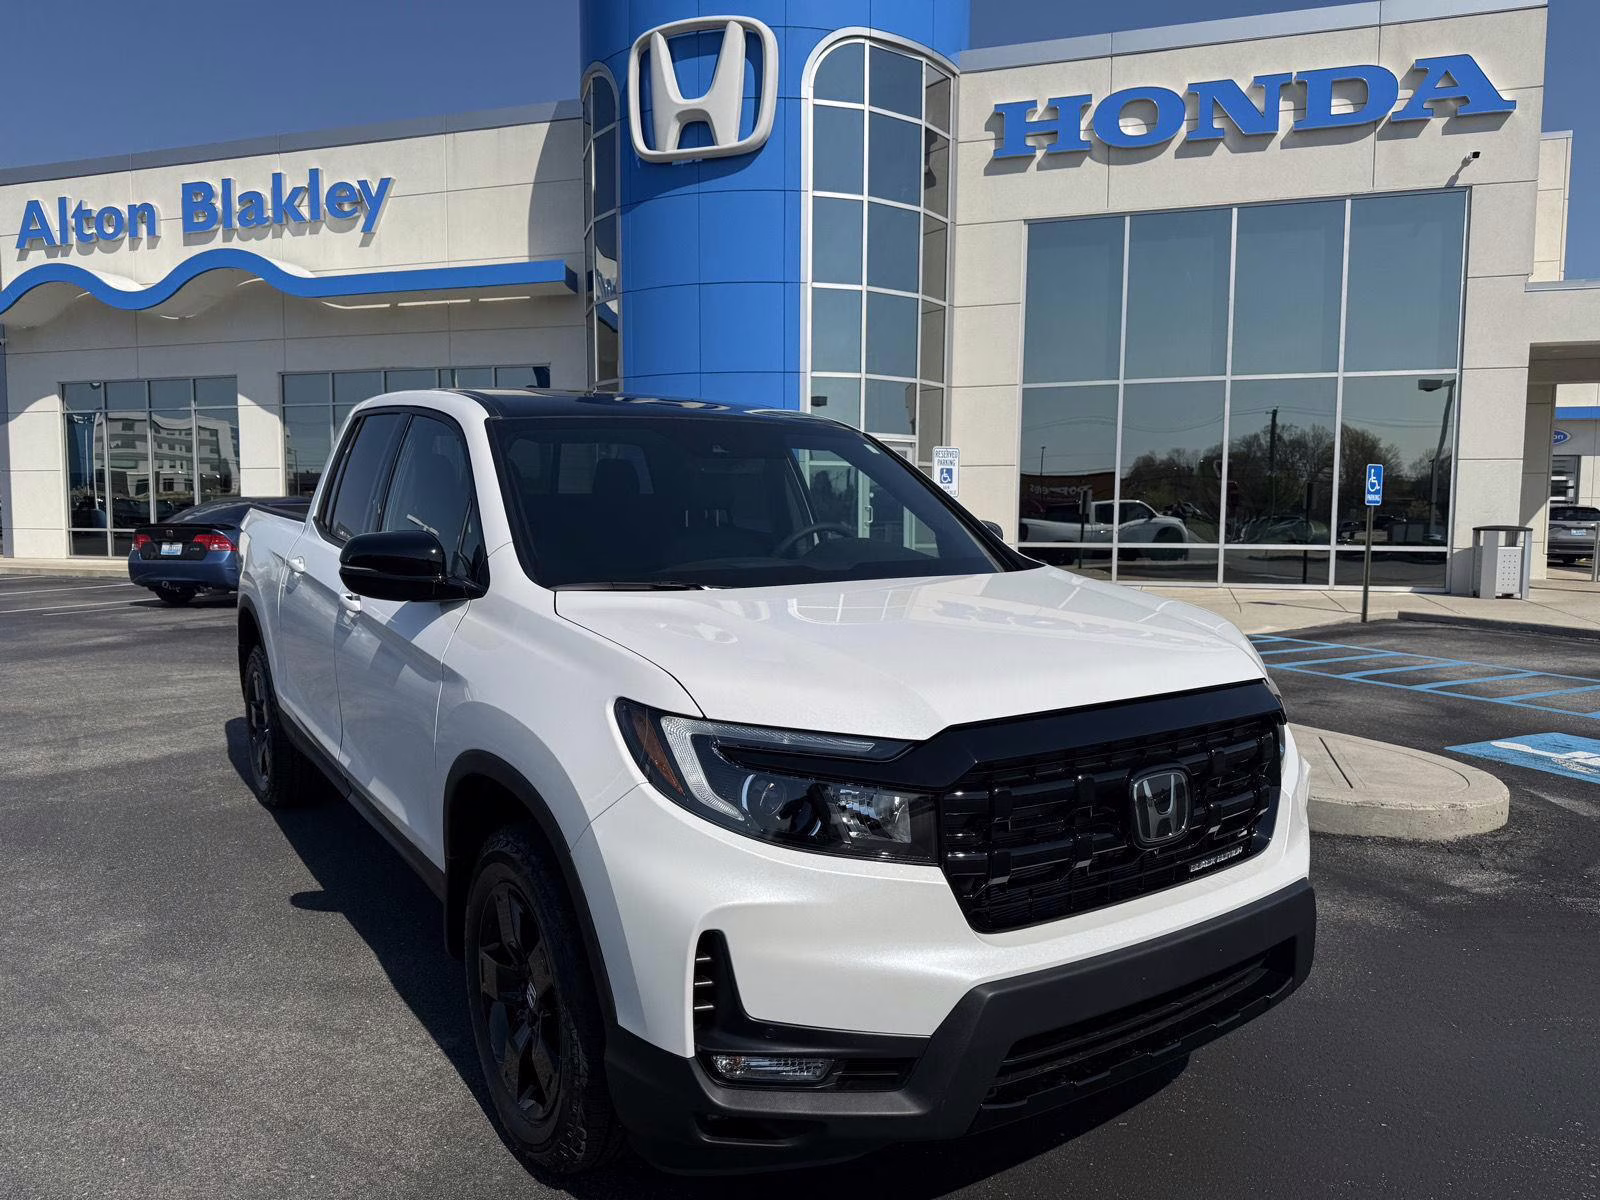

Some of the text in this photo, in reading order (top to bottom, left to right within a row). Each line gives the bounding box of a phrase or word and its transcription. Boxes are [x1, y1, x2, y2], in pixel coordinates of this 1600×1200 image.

[993, 53, 1517, 159] HONDA
[16, 168, 393, 249] Alton Blakley
[935, 450, 958, 458] RESERVED
